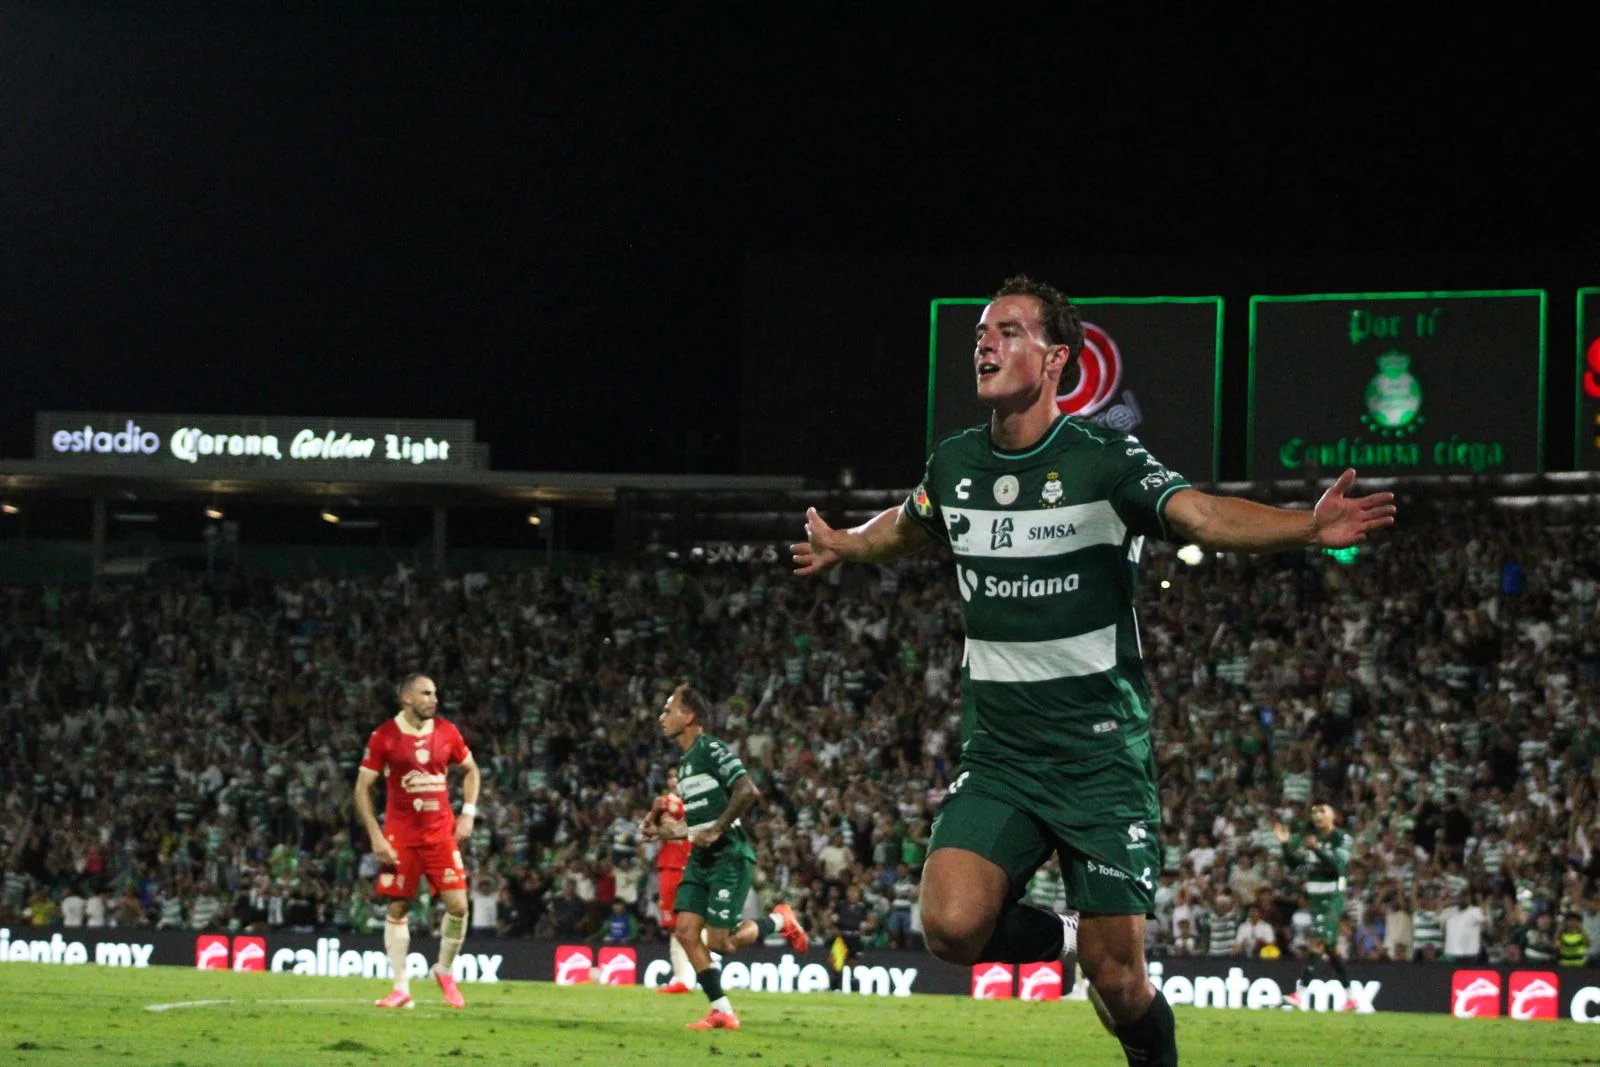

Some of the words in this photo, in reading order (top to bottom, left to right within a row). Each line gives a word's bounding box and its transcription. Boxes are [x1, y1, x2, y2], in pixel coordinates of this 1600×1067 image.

[1349, 309, 1400, 344] Por
[52, 419, 160, 454] estadio
[170, 427, 282, 463] Corona
[290, 428, 375, 460] Golden
[384, 433, 450, 465] Light
[1027, 522, 1077, 541] SIMSA
[984, 573, 1080, 598] Soriana
